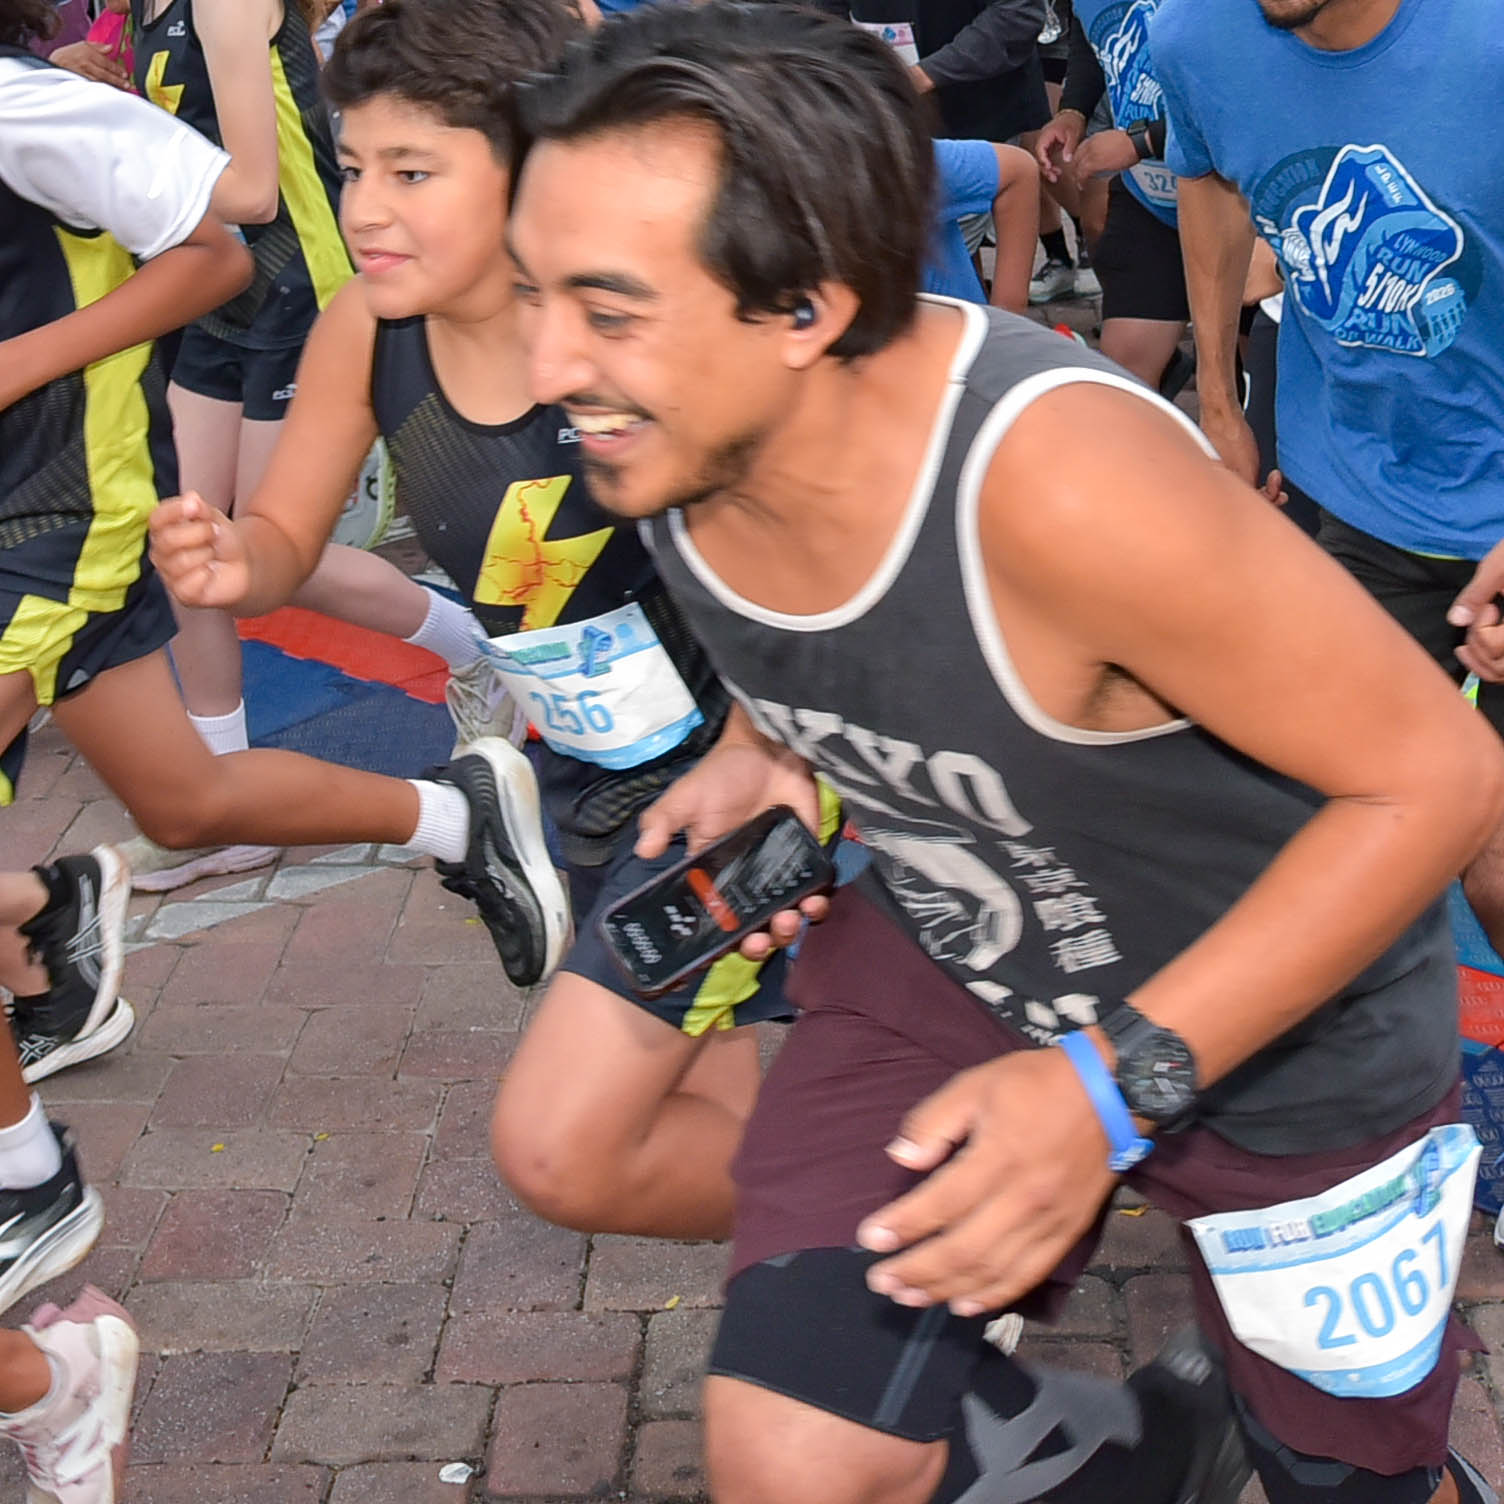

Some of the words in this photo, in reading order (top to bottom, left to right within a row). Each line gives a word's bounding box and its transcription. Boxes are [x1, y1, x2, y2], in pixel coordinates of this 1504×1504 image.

[1376, 246, 1430, 282] RUN
[1344, 307, 1418, 336] RUN
[529, 689, 615, 736] 256
[1303, 1218, 1449, 1351] 2067
